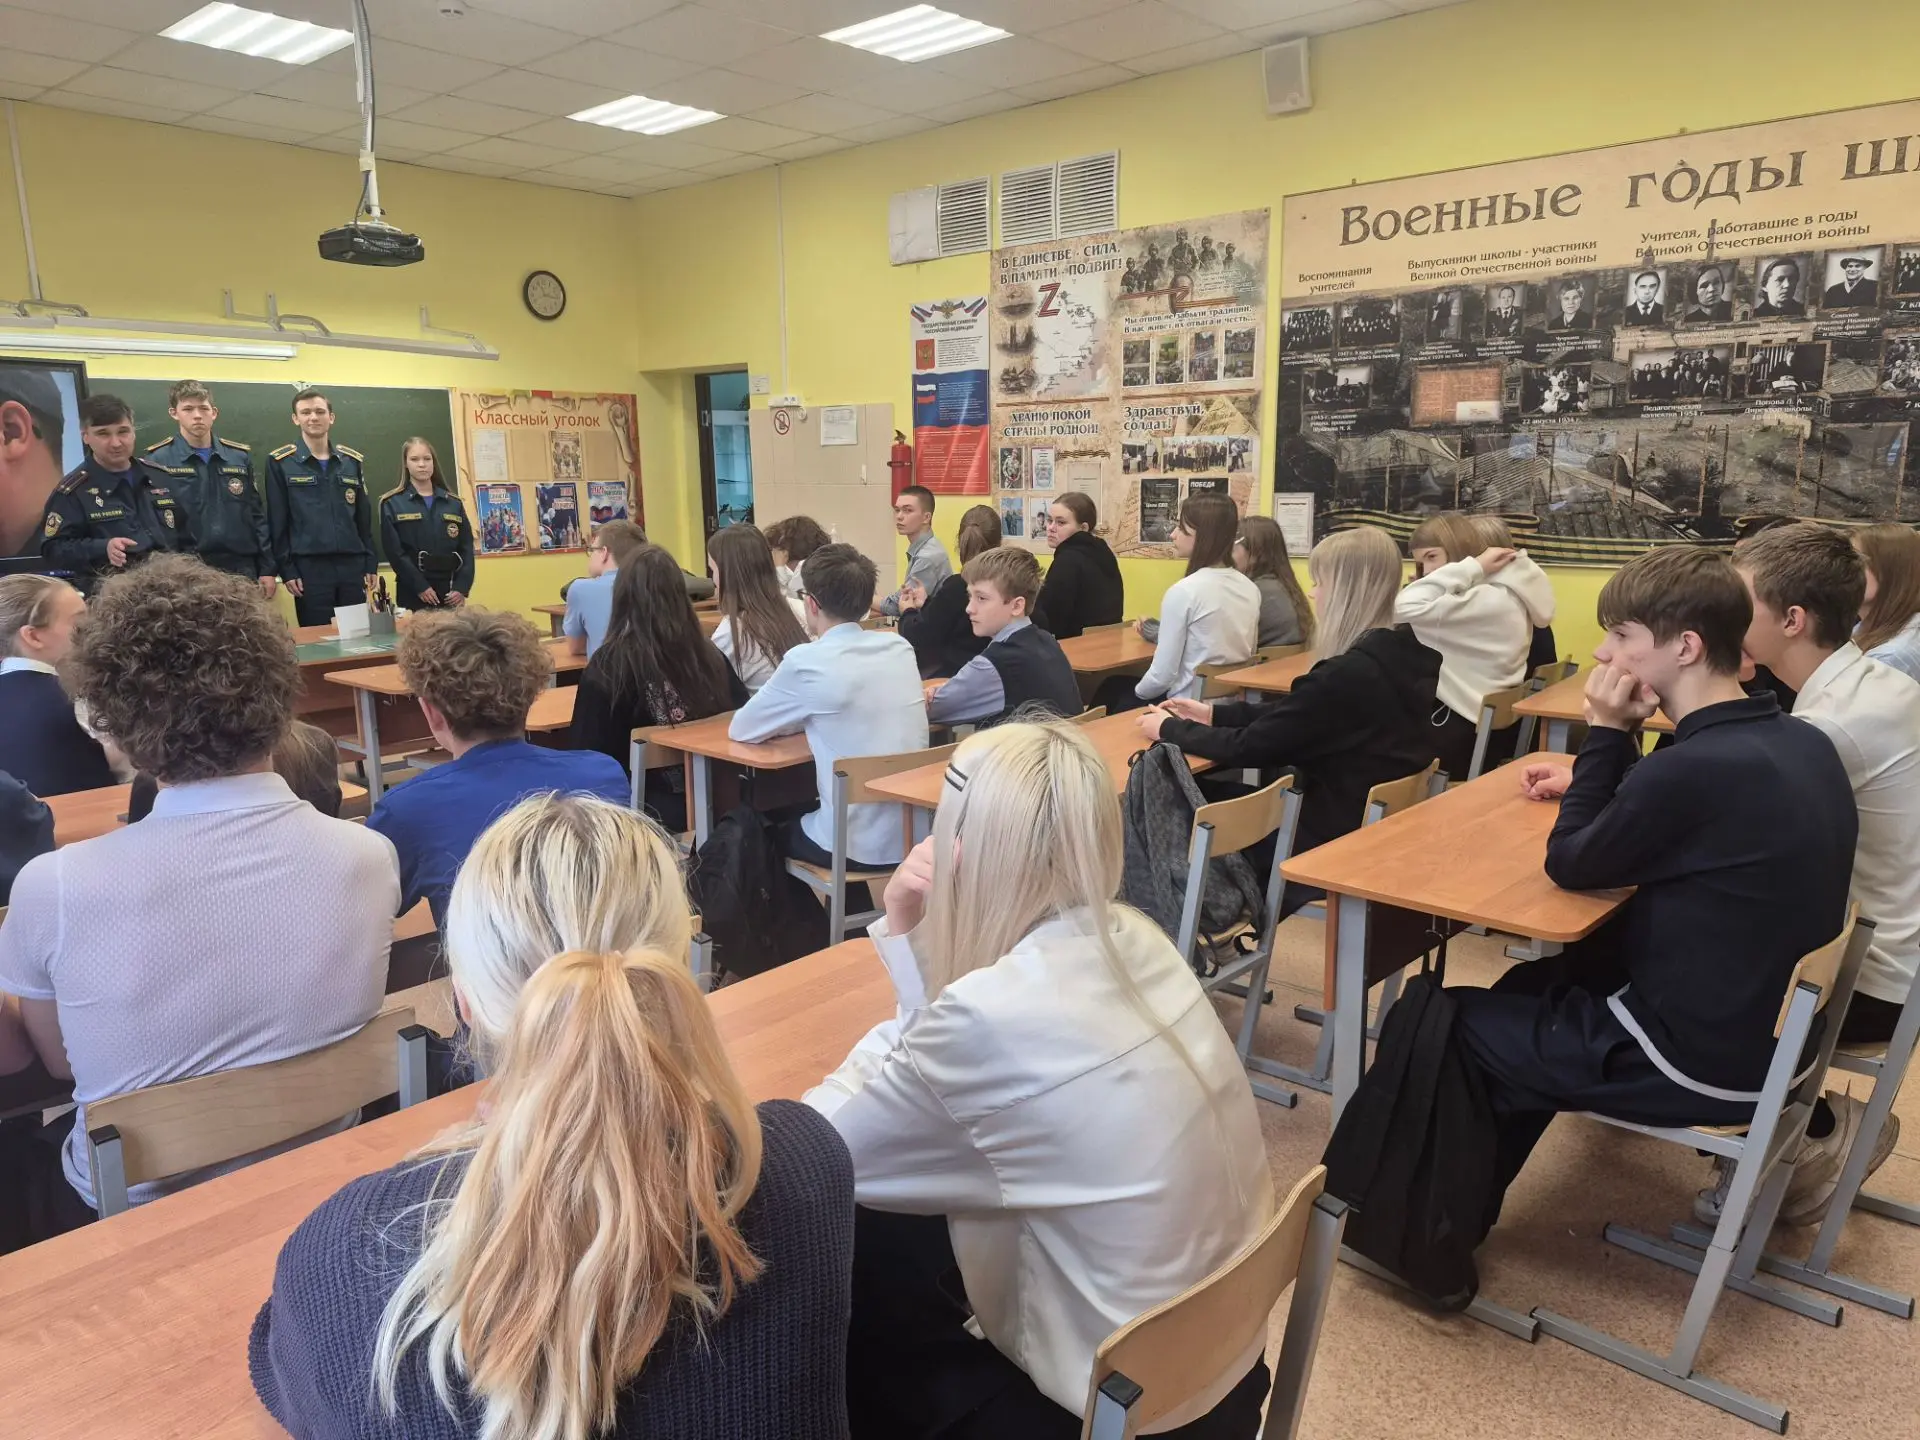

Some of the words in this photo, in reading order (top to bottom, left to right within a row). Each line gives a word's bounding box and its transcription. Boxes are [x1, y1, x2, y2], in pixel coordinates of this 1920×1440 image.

[1339, 184, 1582, 246] Военные
[1625, 150, 1808, 210] годы
[1841, 134, 1920, 181] ш
[1641, 228, 1701, 244] Учителя,
[1707, 216, 1799, 239] работавшие
[1804, 215, 1813, 225] в
[1818, 210, 1858, 225] годы
[1635, 243, 1693, 258] Великой
[1697, 230, 1813, 252] Отечественной
[1818, 224, 1871, 239] войны
[1001, 258, 1009, 269] В
[1012, 249, 1072, 267] ЕДИНСТВЕ
[1407, 254, 1477, 270] Выпускники
[1480, 249, 1522, 262] школы
[1532, 240, 1598, 258] участники
[1000, 273, 1008, 284] В
[1011, 267, 1057, 283] ПАМЯТИ
[1068, 258, 1122, 276] ПОДВИГ!
[1299, 266, 1372, 283] Воспоминания
[1410, 267, 1457, 282] Великой
[1460, 257, 1552, 277] Отечественной
[1555, 254, 1597, 267] войны
[1310, 280, 1355, 295] учителей
[1124, 317, 1137, 325] Мы
[1139, 315, 1162, 323] отцов
[1177, 310, 1207, 319] забыли
[474, 409, 549, 426] Классный
[553, 413, 601, 430] уголок
[1011, 411, 1049, 423] ХРАНЮ
[1123, 402, 1205, 420] Здравствуй,
[1004, 426, 1047, 437] СТРАНЫ
[1123, 418, 1172, 431] солдат!
[1190, 481, 1216, 489] ПОБЕДА
